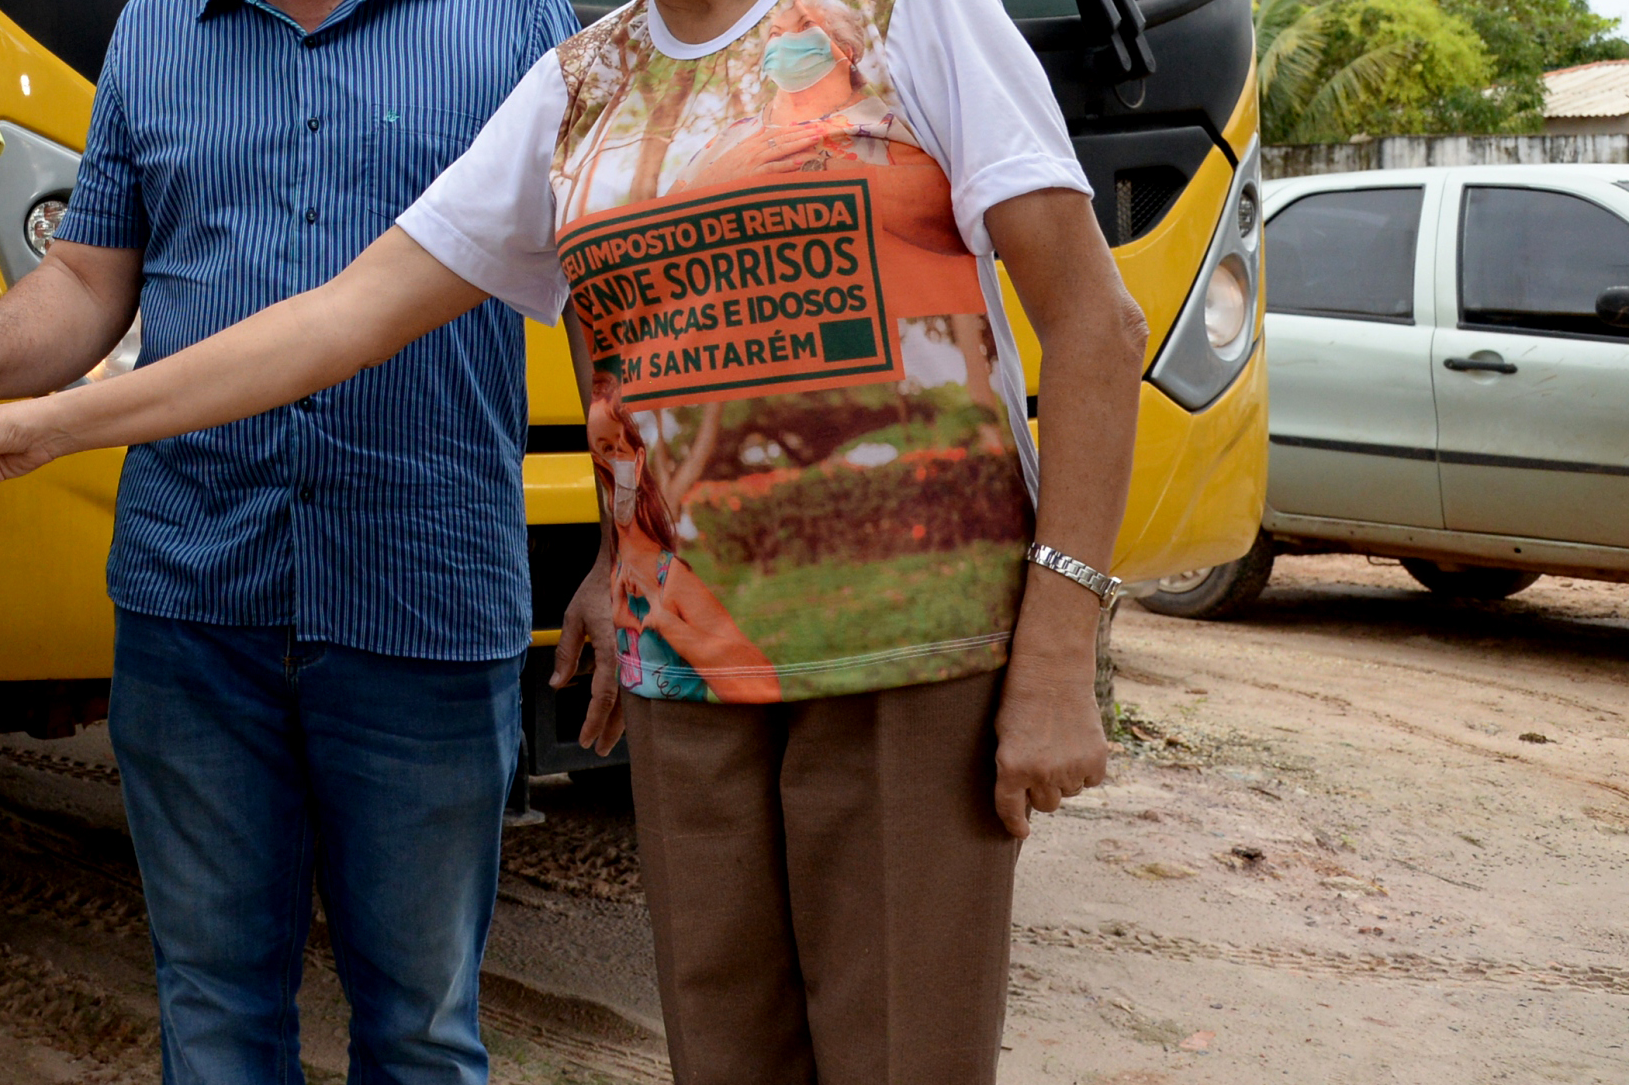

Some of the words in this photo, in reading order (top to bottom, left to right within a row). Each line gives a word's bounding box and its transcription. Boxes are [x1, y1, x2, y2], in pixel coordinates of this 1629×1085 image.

[585, 222, 698, 271] IMPOSTO
[702, 214, 741, 244] DE
[742, 200, 855, 234] RENDA
[664, 236, 860, 302] SORRISOS
[611, 303, 719, 346] CRIANÇAS
[724, 300, 743, 328] E
[747, 284, 867, 325] IDOSOS
[649, 330, 818, 379] SANTARÉM
